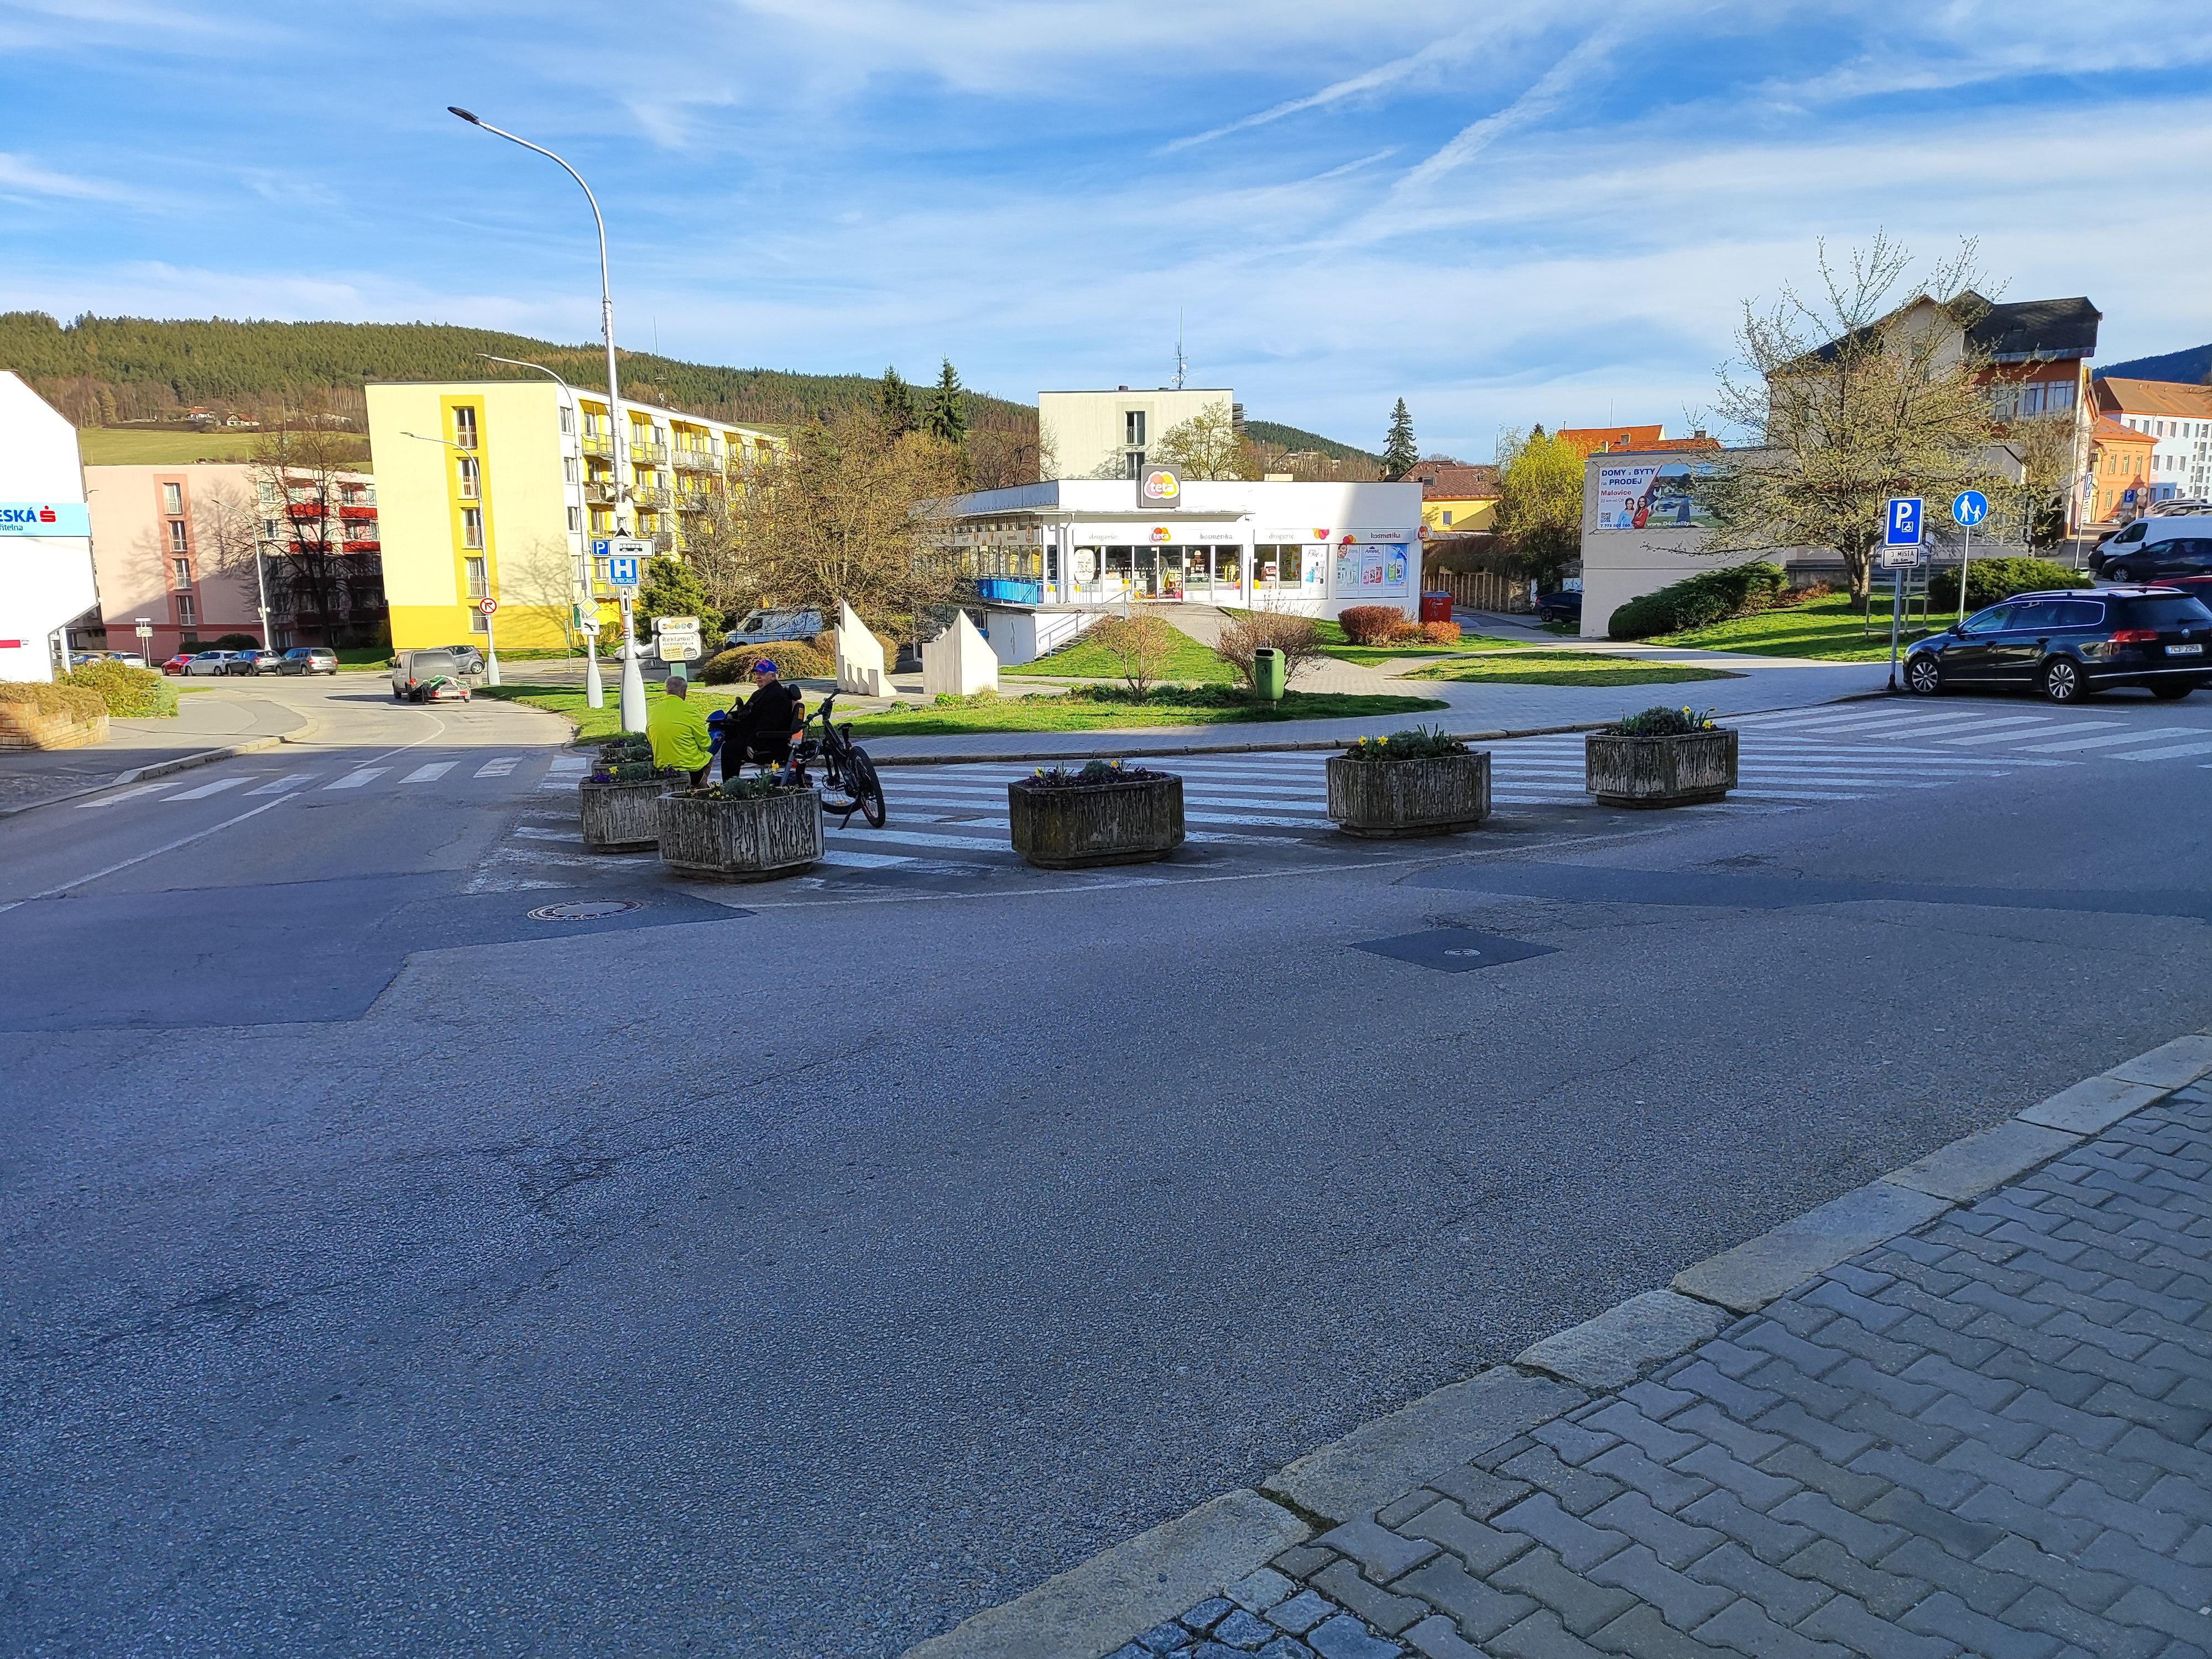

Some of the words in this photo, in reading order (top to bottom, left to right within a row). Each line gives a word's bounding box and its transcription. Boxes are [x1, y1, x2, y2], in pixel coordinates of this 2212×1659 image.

[1150, 482, 1175, 493] teta
[1896, 502, 1912, 529] P
[596, 541, 606, 554] P
[614, 560, 633, 578] H
